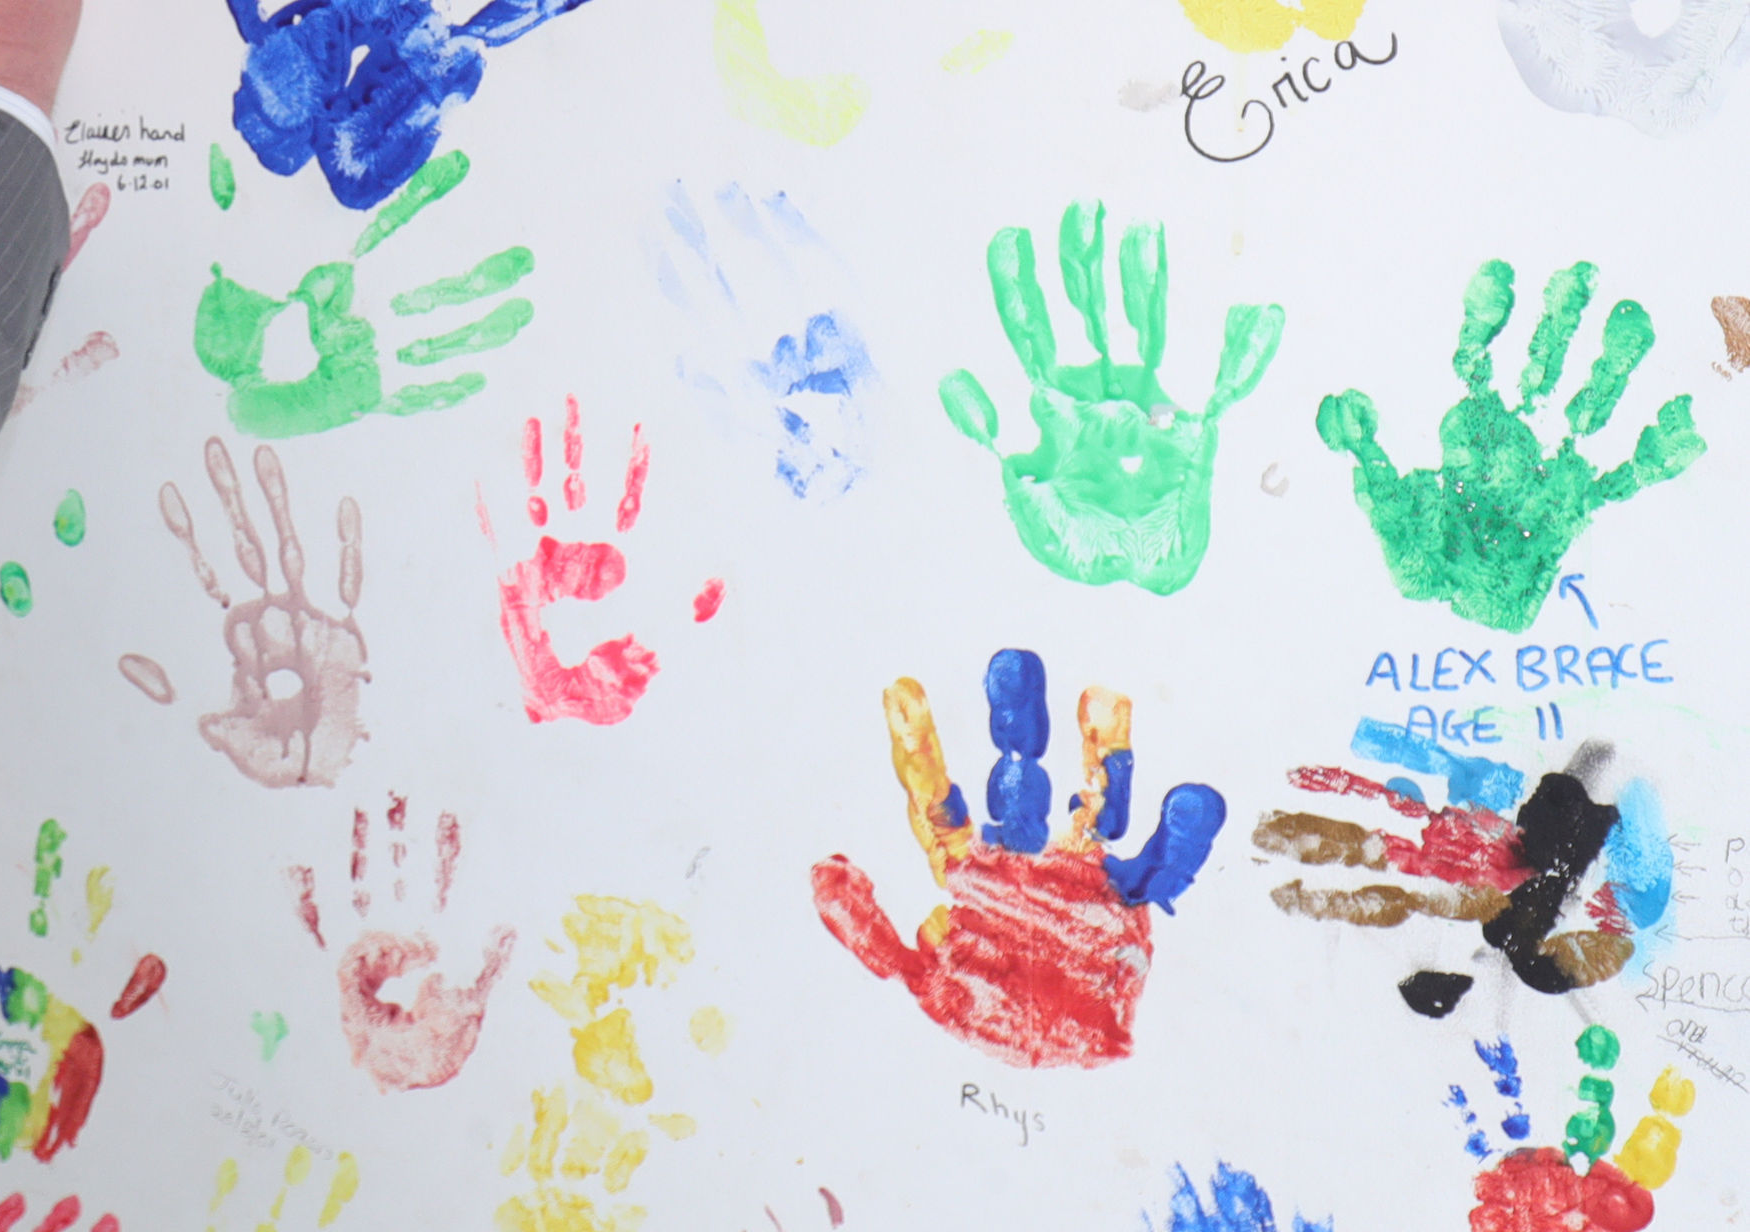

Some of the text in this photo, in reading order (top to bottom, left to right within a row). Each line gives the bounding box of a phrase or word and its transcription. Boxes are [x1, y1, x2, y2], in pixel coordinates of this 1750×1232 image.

[1180, 29, 1399, 164] Erica
[139, 114, 186, 143] hand
[132, 154, 169, 169] mum
[1365, 637, 1675, 693] ALEX BRACE
[1403, 703, 1503, 748] AGE
[961, 1081, 1049, 1149] Rhys
